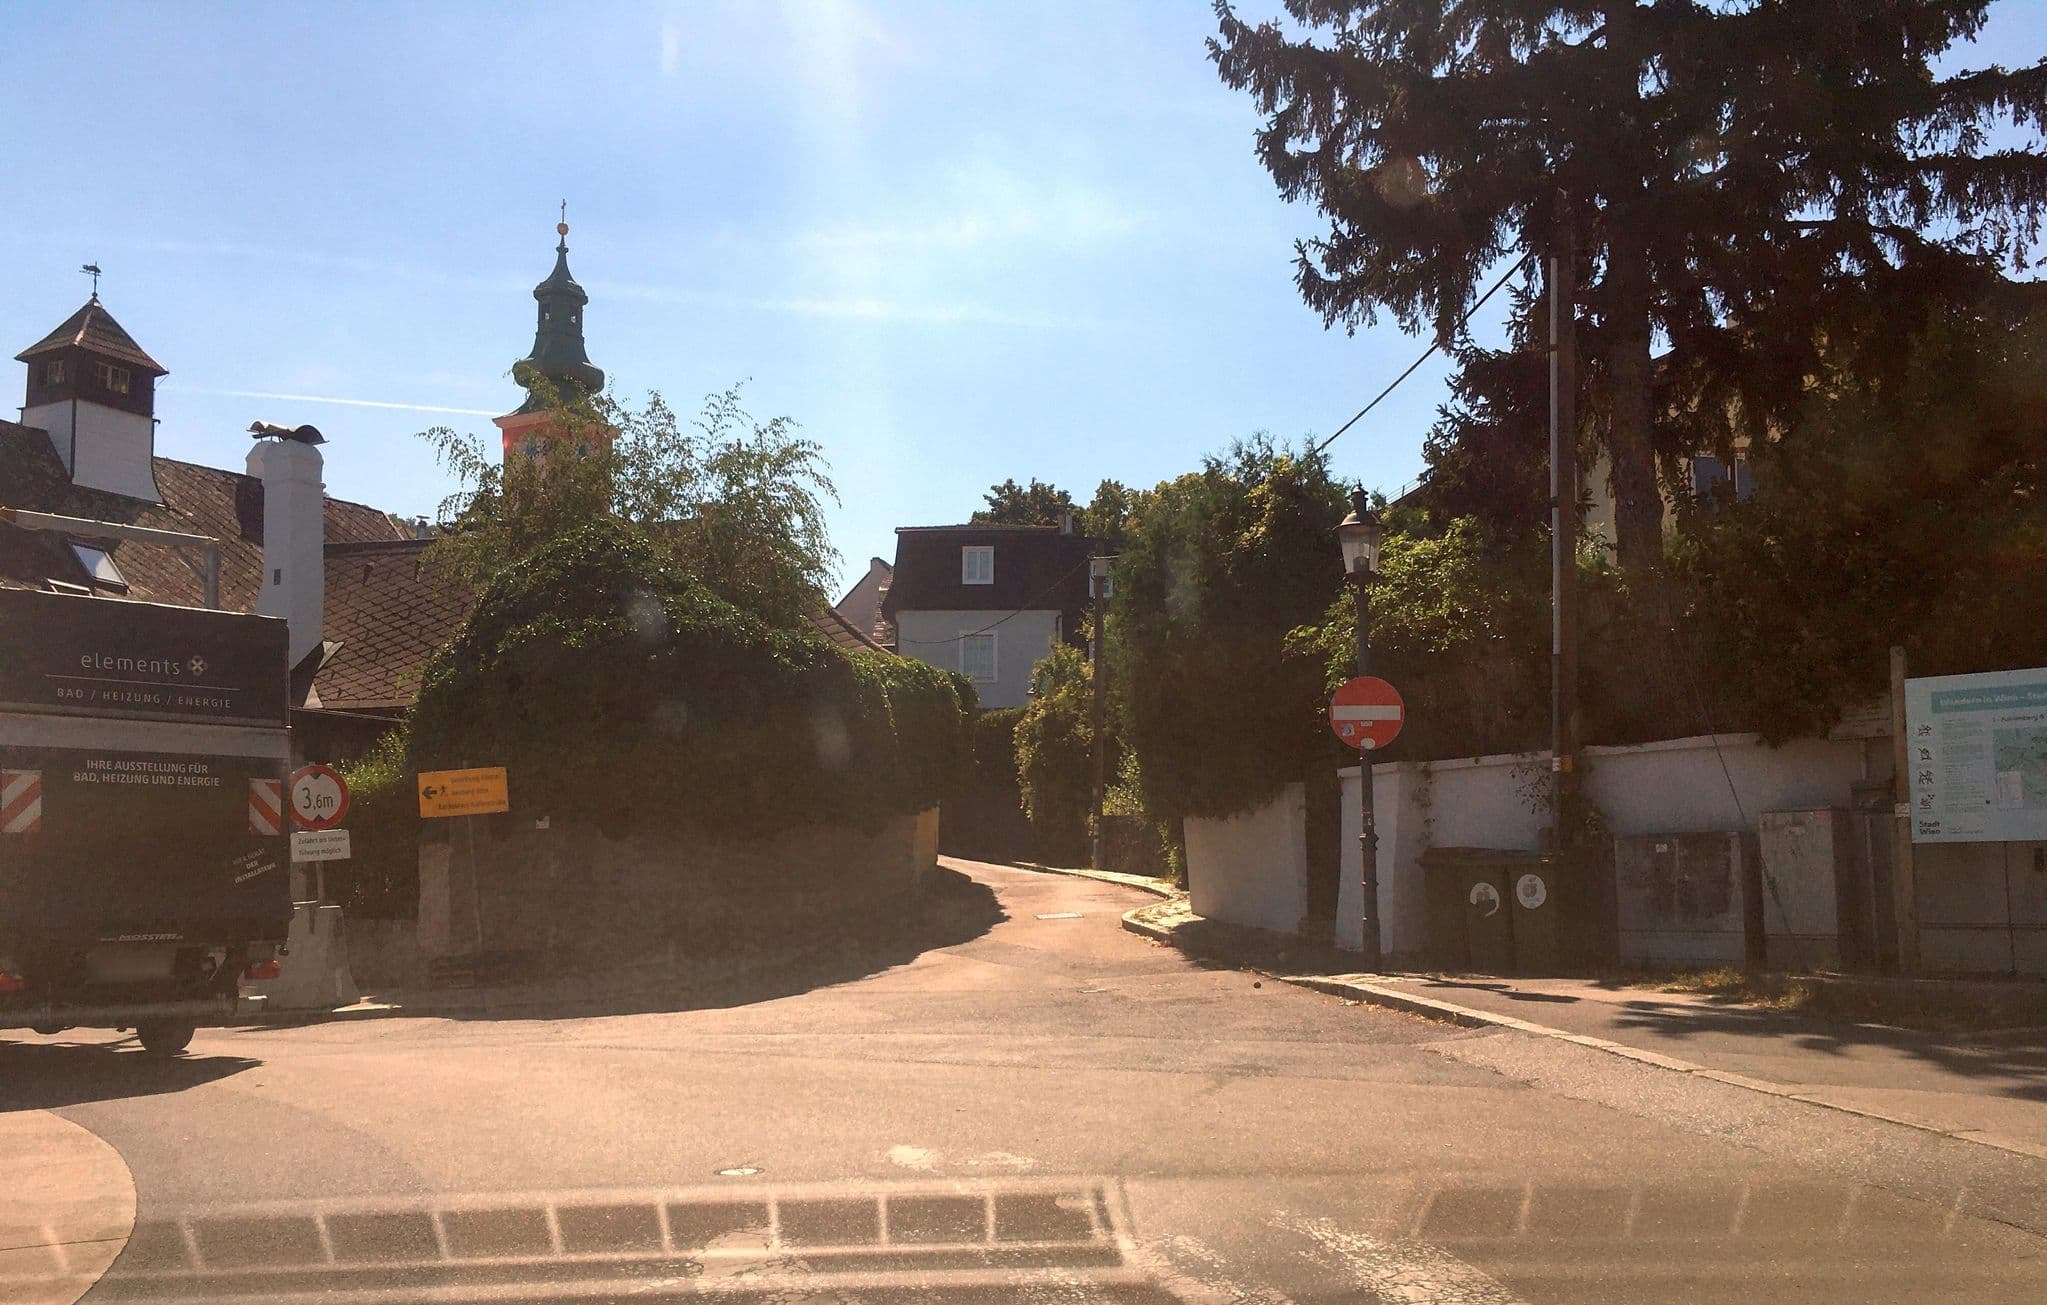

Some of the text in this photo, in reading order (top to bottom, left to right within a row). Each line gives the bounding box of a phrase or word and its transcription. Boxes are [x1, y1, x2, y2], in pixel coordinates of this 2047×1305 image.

[80, 652, 181, 676] elements
[57, 687, 84, 699] BAD
[102, 691, 160, 705] HEIZUNG
[178, 696, 232, 709] ENERGIE
[86, 759, 208, 774] IHRE AUSSTELLUNG FÜR
[73, 772, 221, 788] BAD, HEIZUNG UND ENERGIE
[302, 786, 334, 810] 3,6m
[1919, 820, 1941, 828] Stadt
